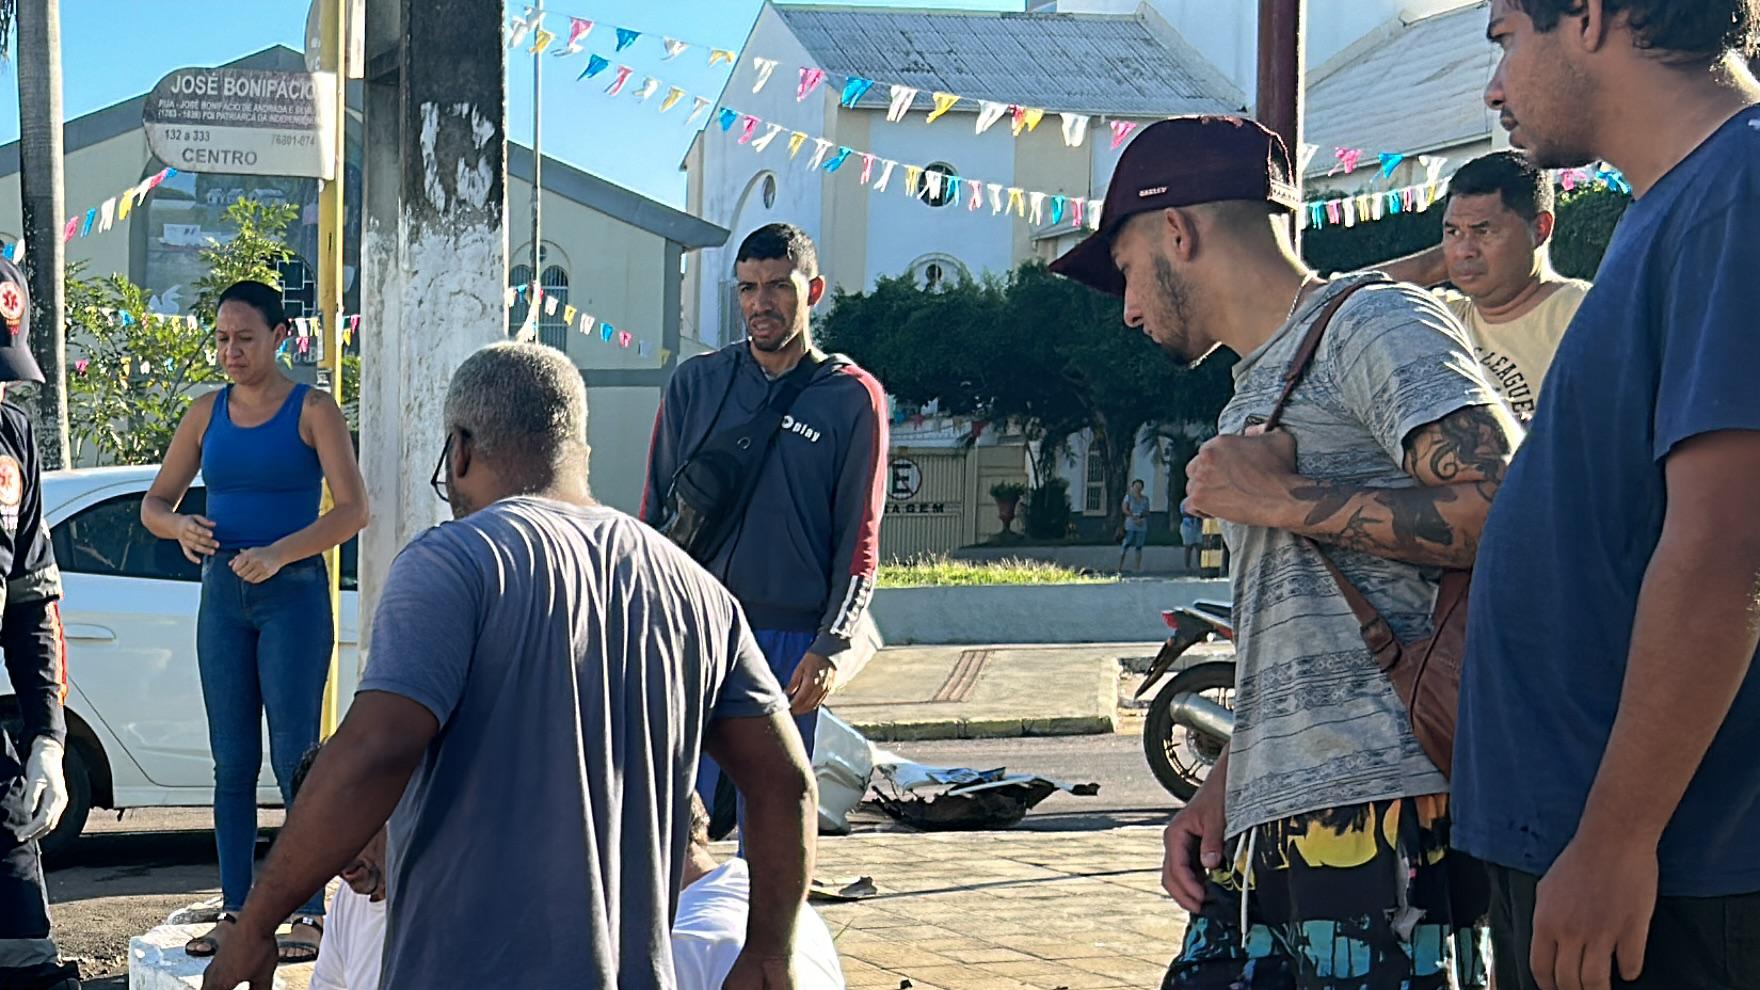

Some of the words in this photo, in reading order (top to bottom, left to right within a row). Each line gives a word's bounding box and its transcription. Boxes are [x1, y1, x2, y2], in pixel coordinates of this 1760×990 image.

[171, 72, 218, 95] JOSÉ
[223, 75, 316, 99] BONIFÁCIO
[182, 147, 258, 166] CENTRO
[1480, 352, 1535, 414] LEAGUE
